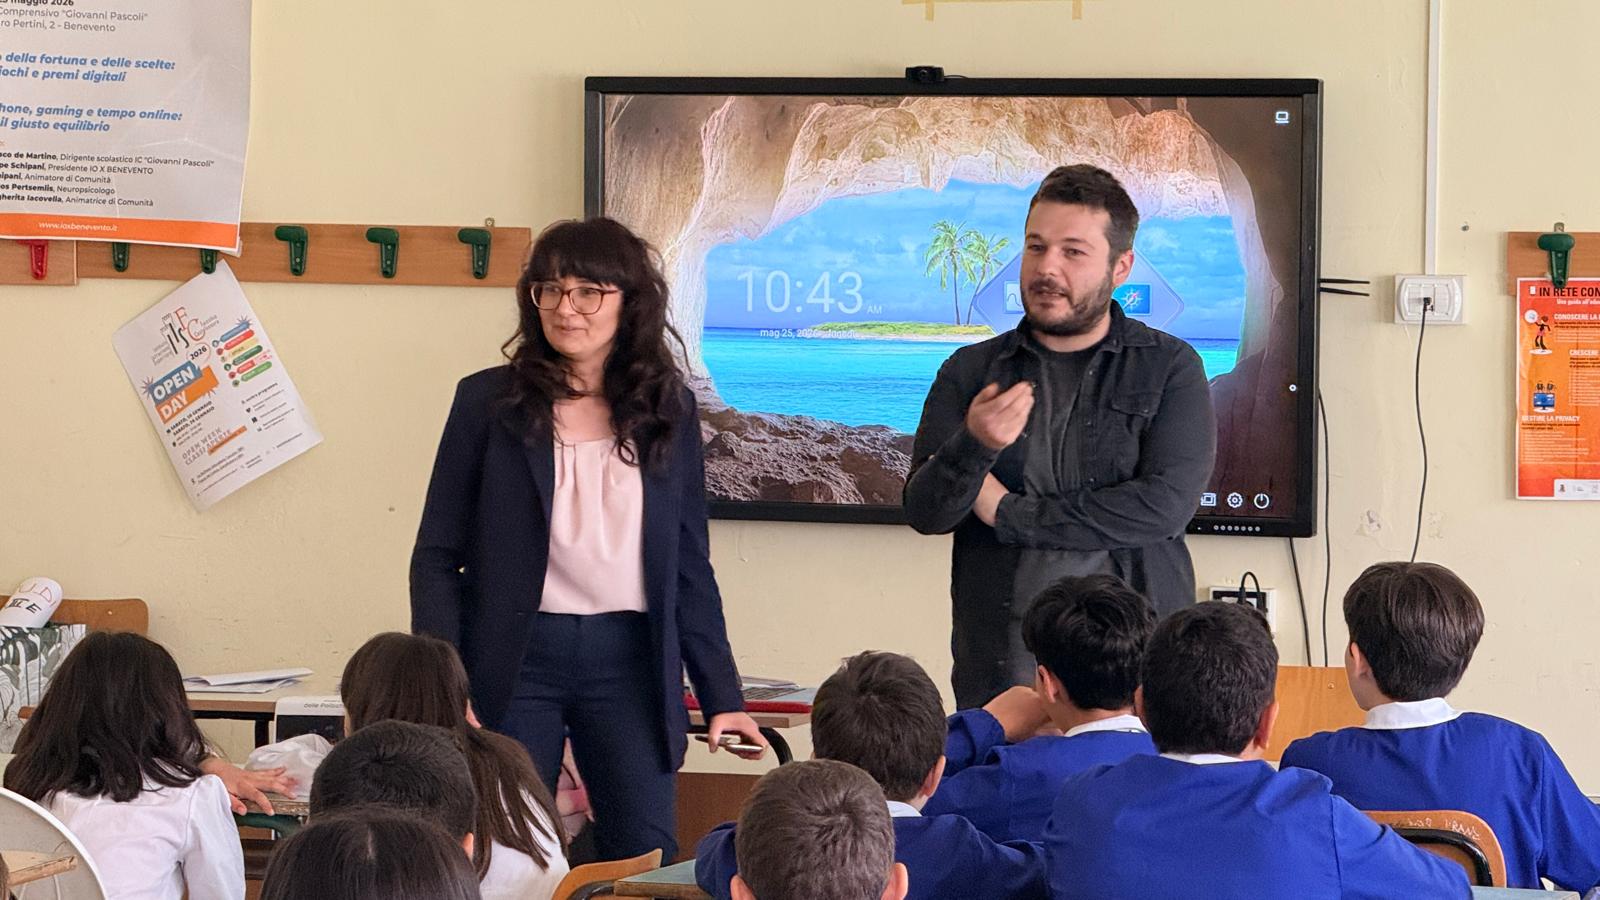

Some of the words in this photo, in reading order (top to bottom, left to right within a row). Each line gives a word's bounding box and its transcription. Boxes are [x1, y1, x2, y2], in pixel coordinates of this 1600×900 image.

[14, 19, 47, 30] Pertini,
[49, 21, 56, 29] 2
[64, 22, 116, 32] Benevento
[6, 52, 37, 63] della
[40, 54, 87, 65] fortuna
[102, 57, 132, 67] delle
[134, 59, 176, 70] scelte:
[42, 69, 80, 80] premi
[82, 70, 127, 83] digitali
[36, 105, 83, 118] gaming
[97, 108, 136, 120] tempo
[139, 109, 182, 120] online:
[10, 117, 50, 130] giusto
[53, 120, 110, 132] equilibrio
[26, 152, 58, 160] Martino,
[60, 153, 95, 162] Dirigente
[97, 155, 133, 163] scolastico
[11, 162, 46, 171] Schipani,
[48, 164, 88, 172] Presidente
[107, 166, 154, 174] BENEVENTO
[25, 173, 64, 182] Animatore
[74, 175, 111, 183] Comunità
[57, 186, 116, 195] Neuropsicologo
[65, 196, 107, 205] Animatrice
[117, 198, 154, 206] Comunità
[736, 270, 864, 314] 10:43
[866, 306, 882, 314] AM
[1539, 287, 1550, 297] IN
[1553, 287, 1578, 297] RETE
[760, 330, 780, 338] mag
[782, 329, 796, 338] 25,
[190, 346, 207, 359] 2026
[153, 366, 195, 400] OPEN
[159, 390, 187, 418] DAY
